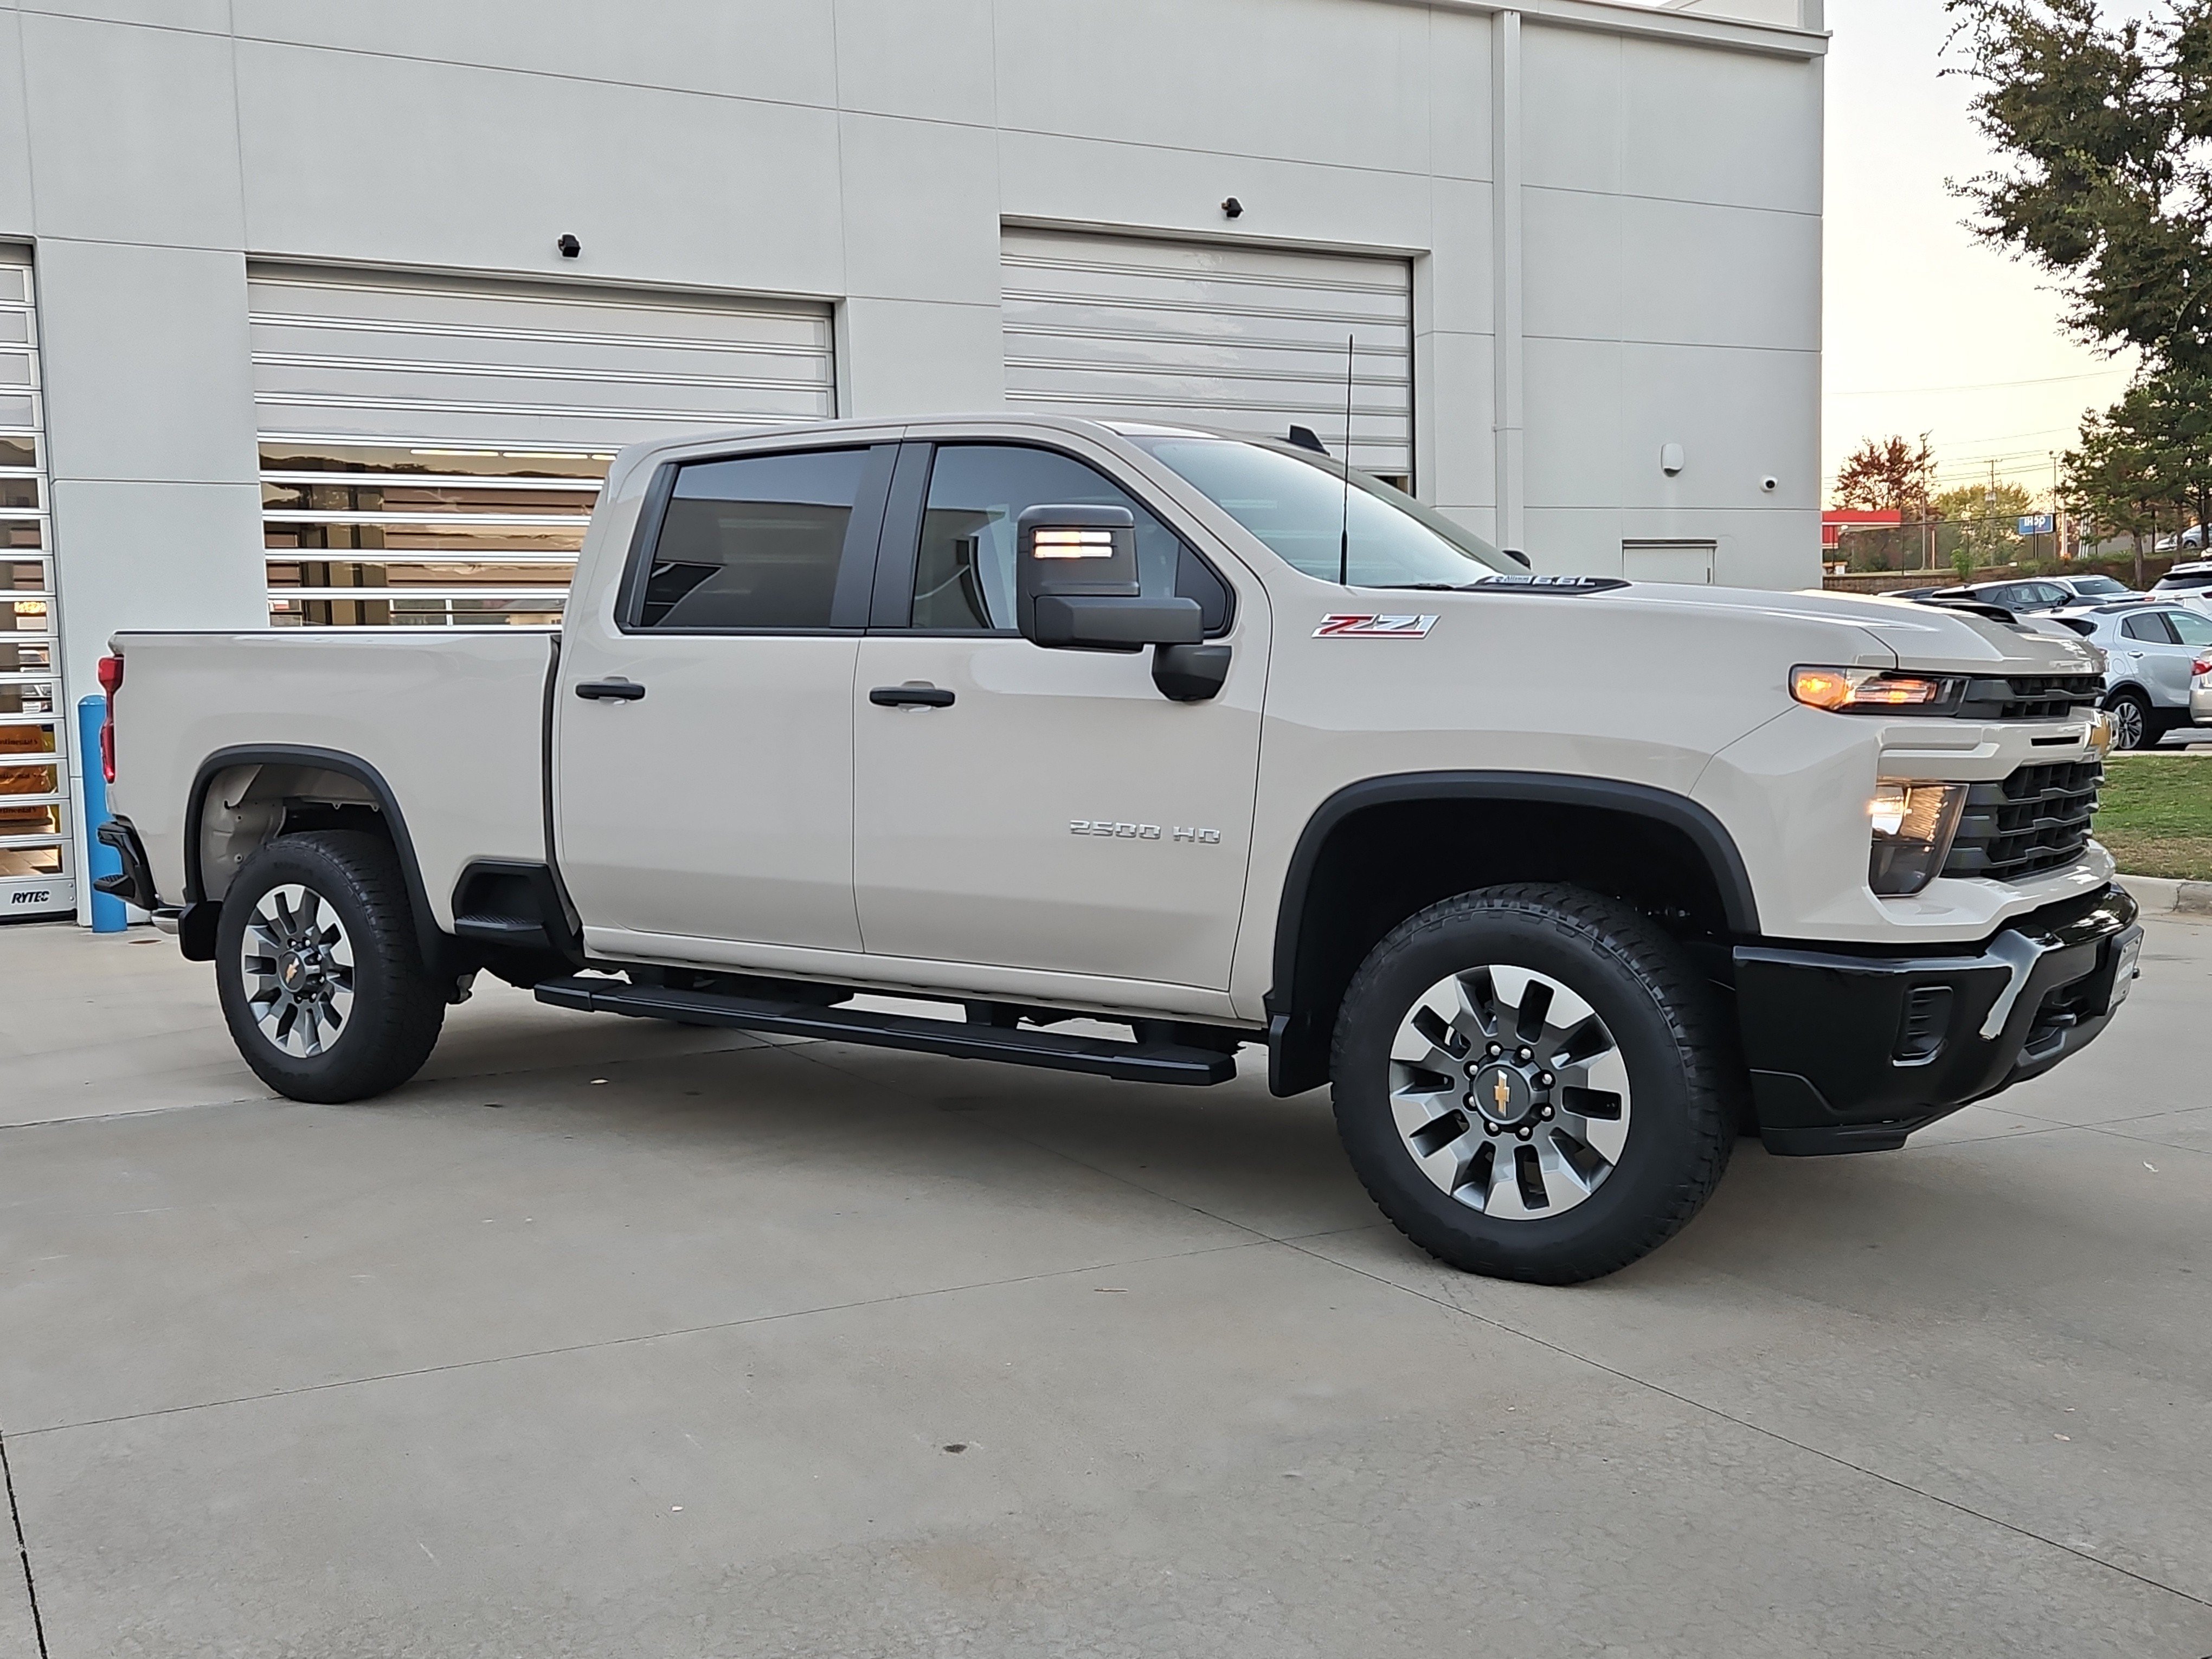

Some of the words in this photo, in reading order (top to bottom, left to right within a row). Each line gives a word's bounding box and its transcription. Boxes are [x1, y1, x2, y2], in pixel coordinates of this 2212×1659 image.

[1532, 575, 1596, 586] 6.6L
[1311, 614, 1441, 639] Z71
[1070, 819, 1161, 839] 2500
[1173, 826, 1220, 844] HD
[11, 891, 50, 904] RYTEC
